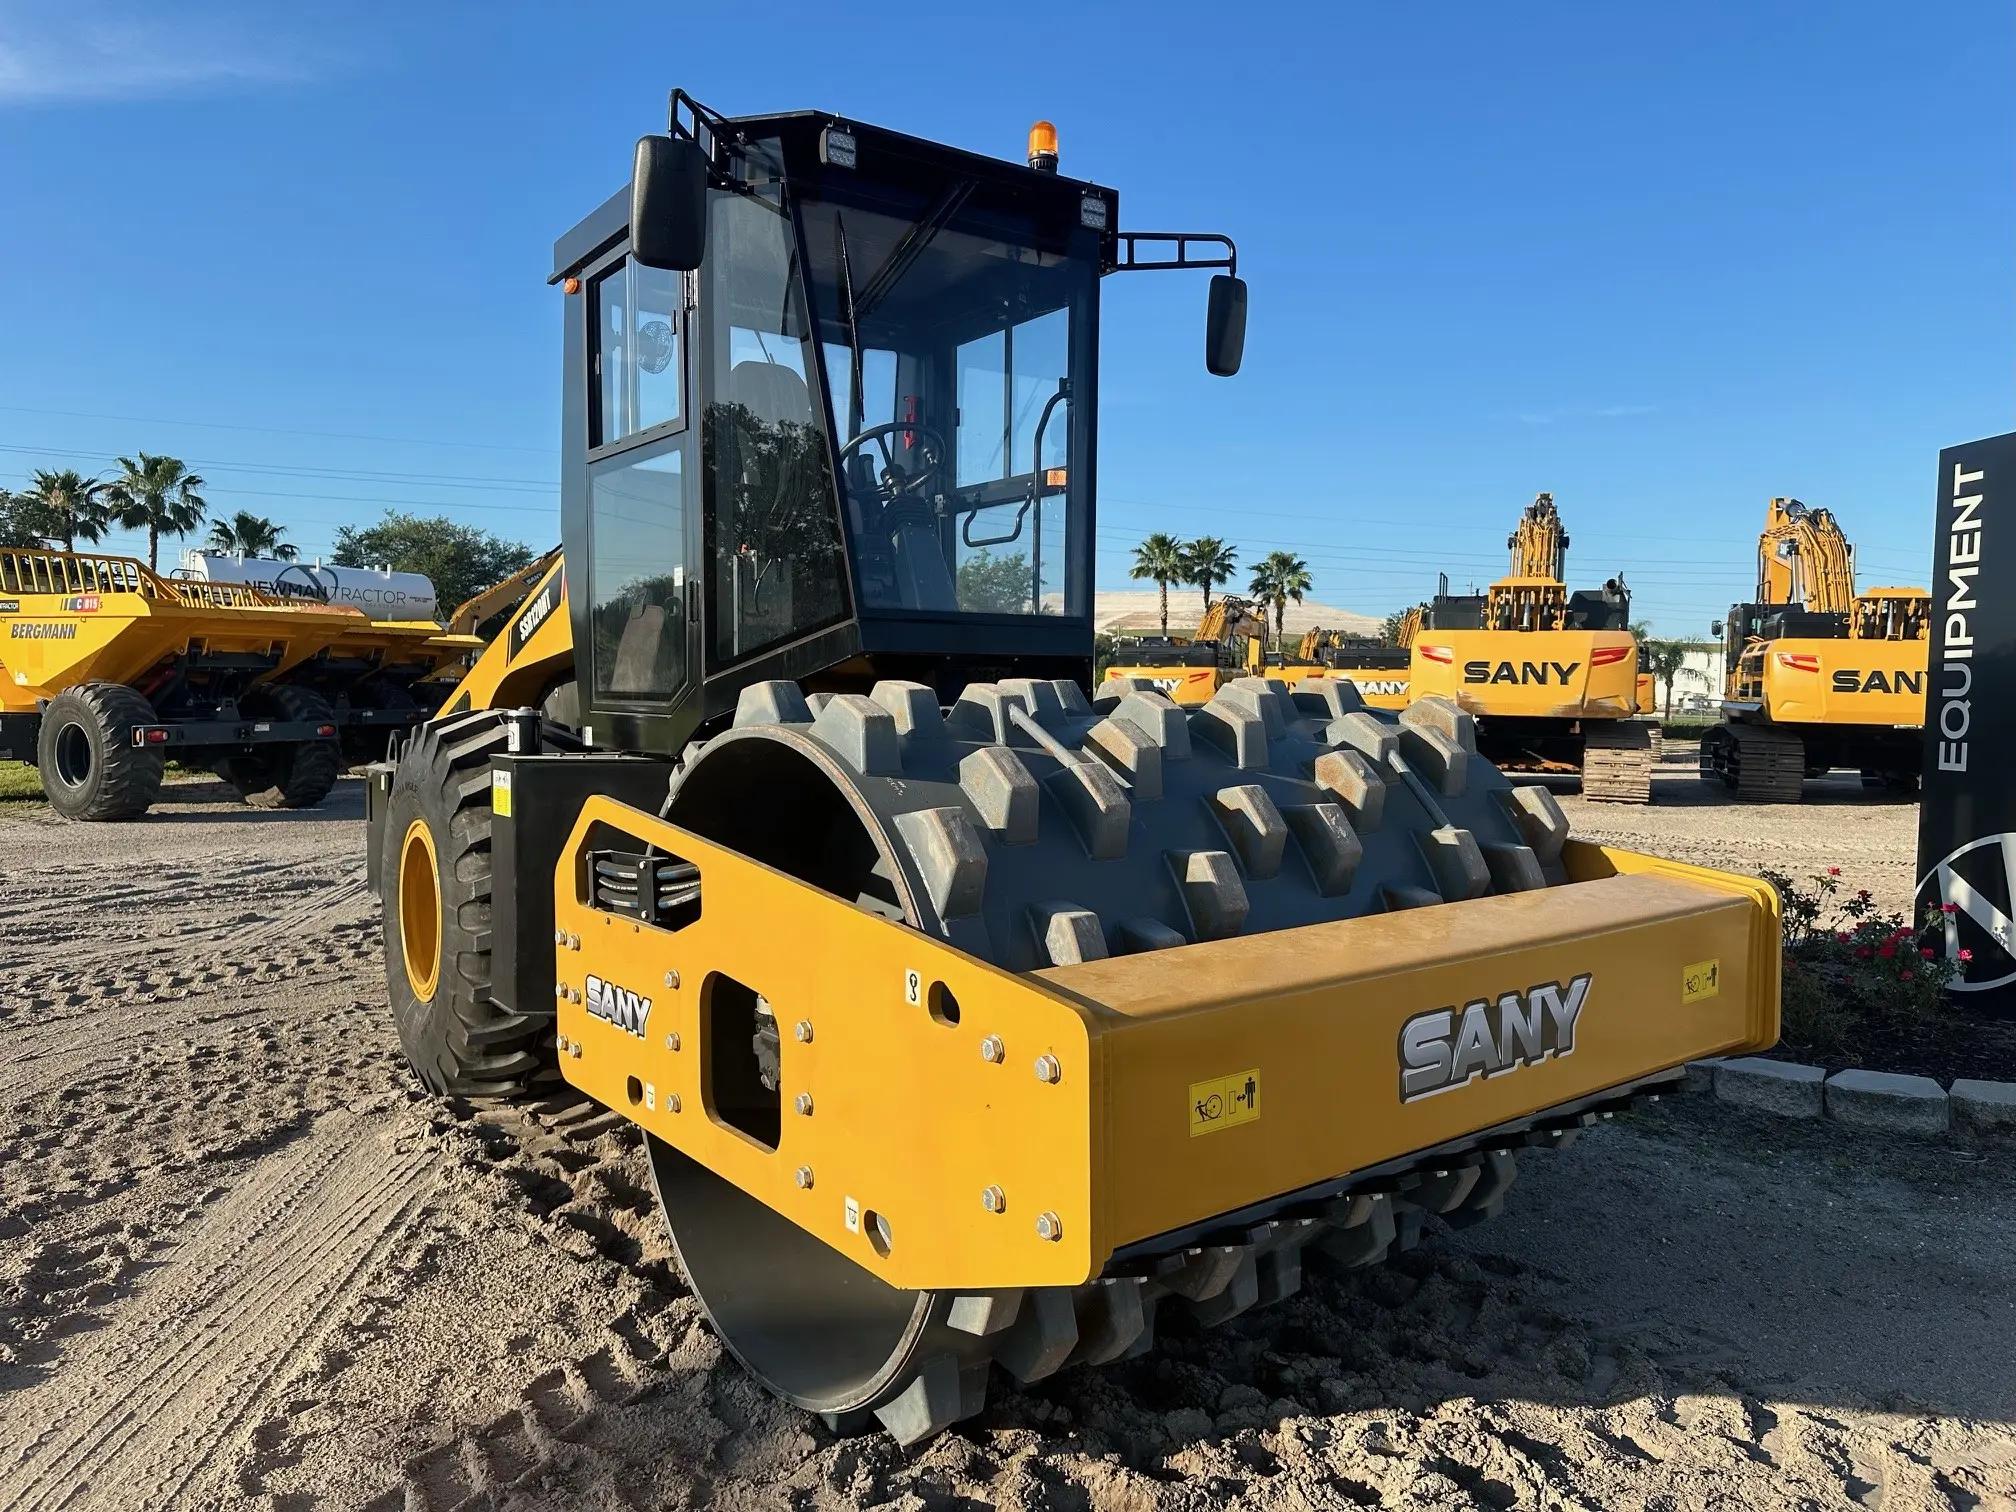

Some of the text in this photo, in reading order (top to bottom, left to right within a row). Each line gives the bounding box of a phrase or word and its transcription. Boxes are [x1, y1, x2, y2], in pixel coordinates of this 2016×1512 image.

[244, 579, 407, 605] NEWMAN TRACTOR
[1937, 463, 1984, 772] EQUIPMENT
[11, 623, 77, 639] BERGMANN
[1463, 661, 1581, 685] SANY
[1832, 670, 1928, 694] SAN
[586, 974, 652, 1038] SANY
[1397, 973, 1592, 1104] SANY
